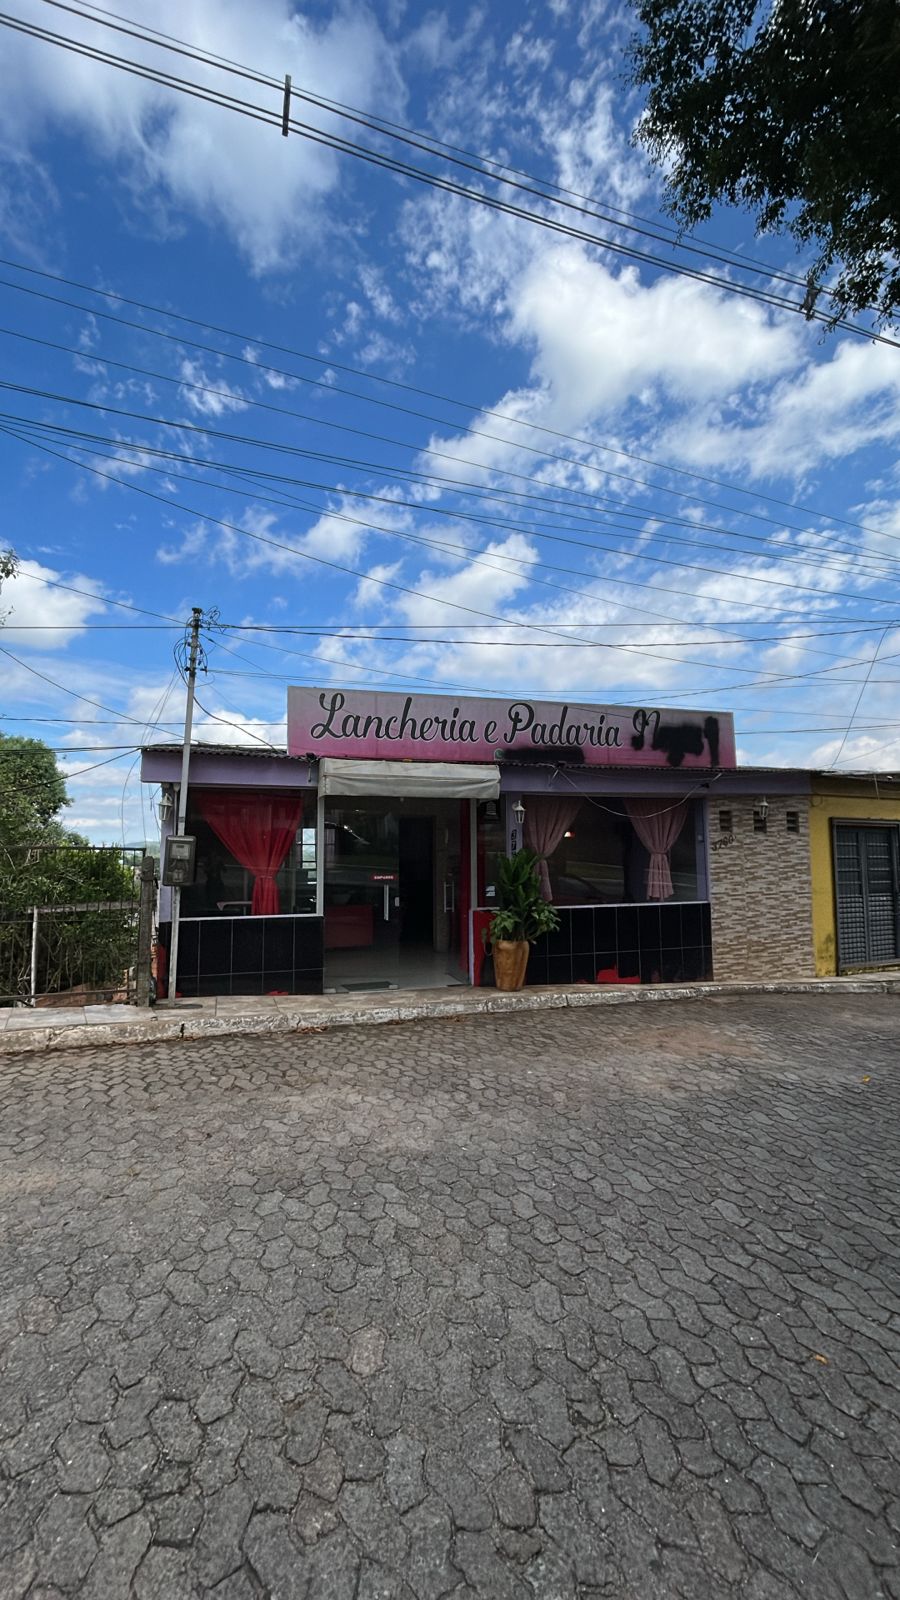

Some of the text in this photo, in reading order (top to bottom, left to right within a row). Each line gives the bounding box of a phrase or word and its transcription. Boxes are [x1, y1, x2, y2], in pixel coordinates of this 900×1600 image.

[310, 692, 479, 742] Lancheria
[484, 719, 499, 743] e
[504, 702, 623, 747] Padaria
